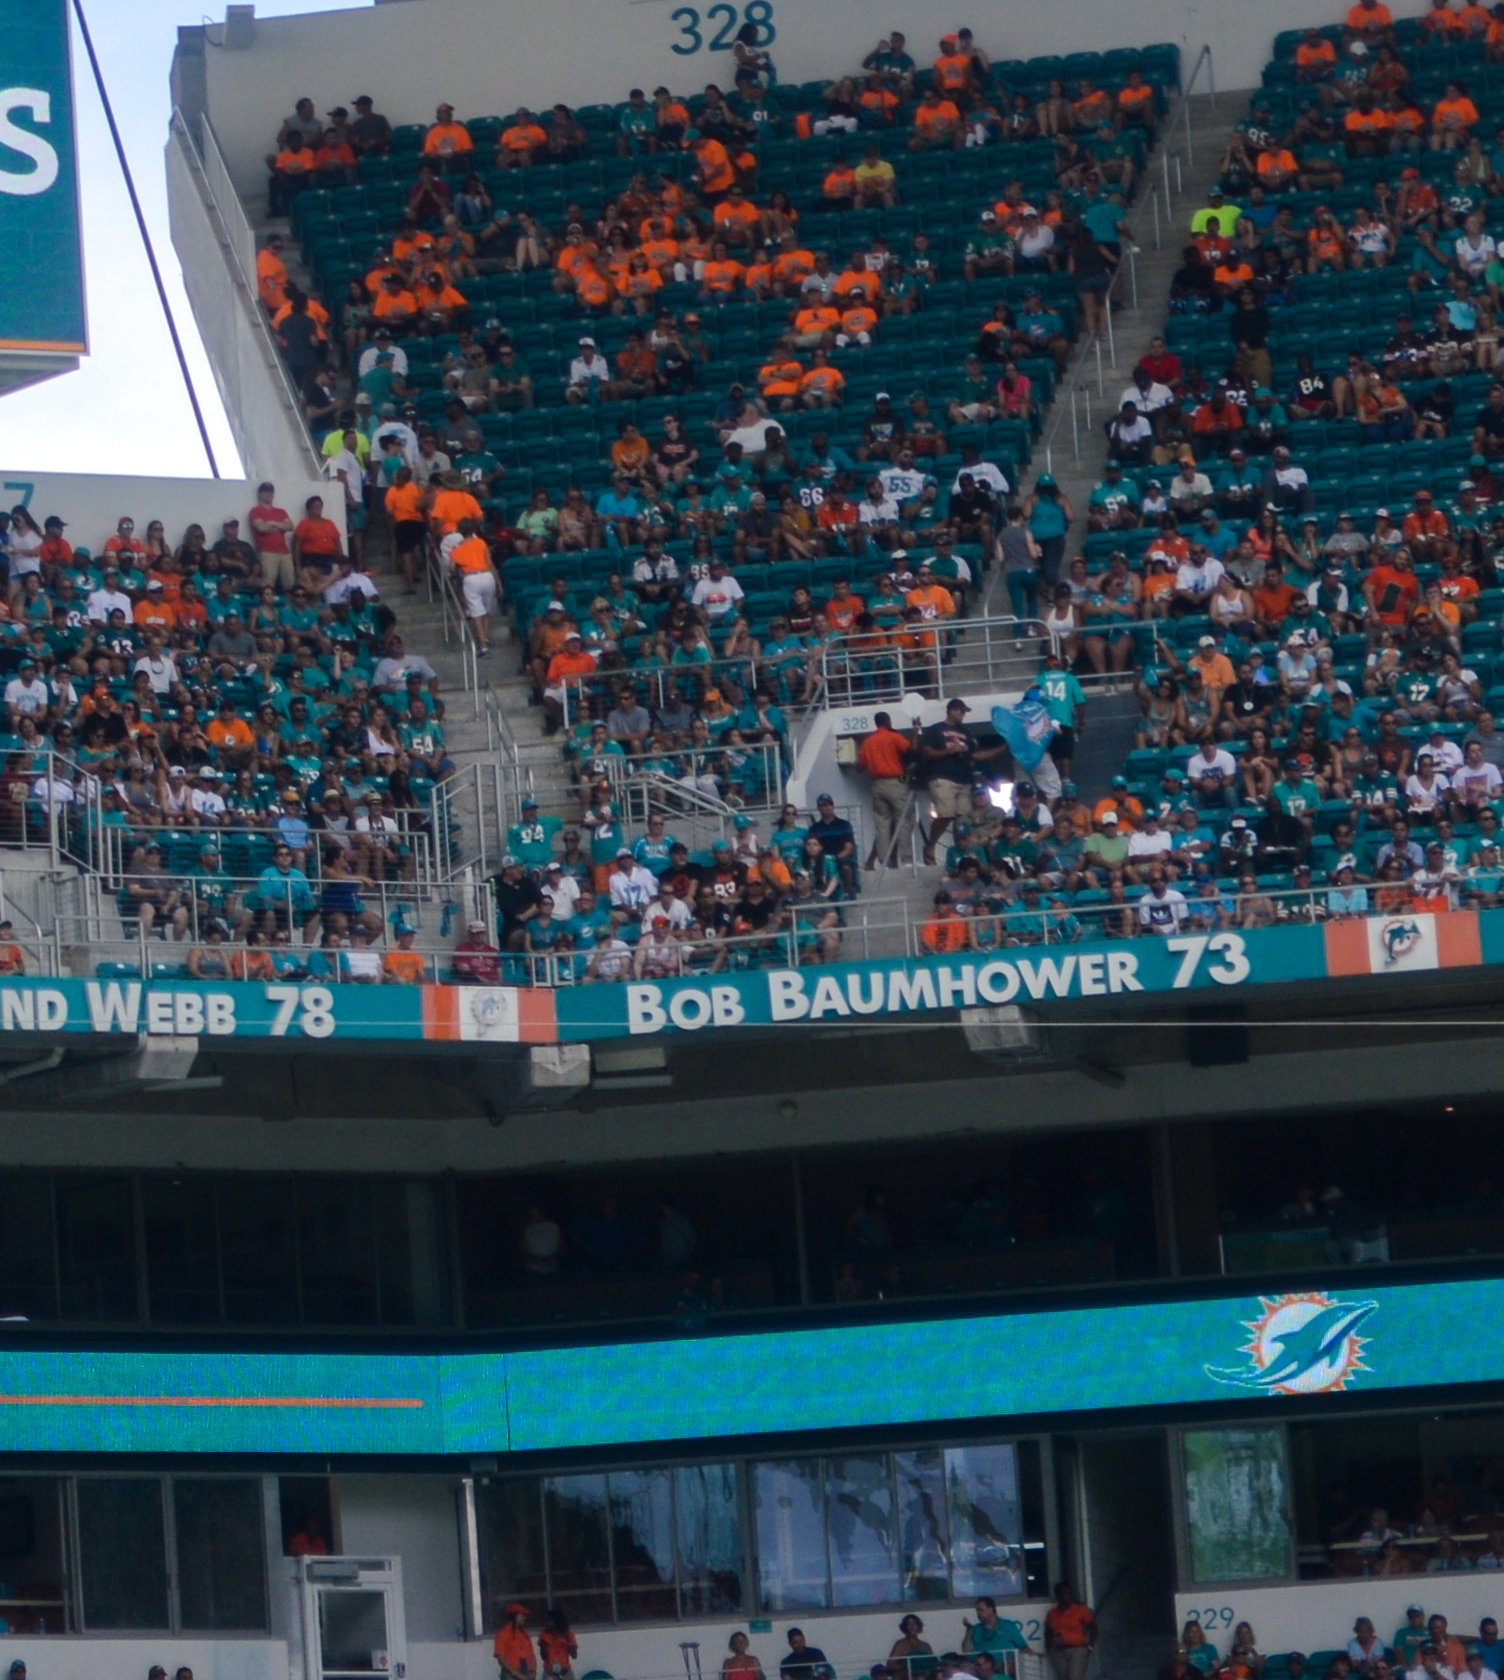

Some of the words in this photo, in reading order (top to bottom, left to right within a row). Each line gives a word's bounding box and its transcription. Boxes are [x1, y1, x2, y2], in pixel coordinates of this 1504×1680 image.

[670, 0, 776, 56] 328
[1299, 374, 1324, 395] 84
[1045, 680, 1066, 702] 14
[1409, 681, 1430, 699] 17
[842, 717, 869, 731] 328
[626, 984, 745, 1035] BOB
[768, 950, 1145, 1022] BAUMHOWER
[1166, 932, 1252, 989] 73
[86, 980, 237, 1038] WEBB
[265, 986, 336, 1040] 78
